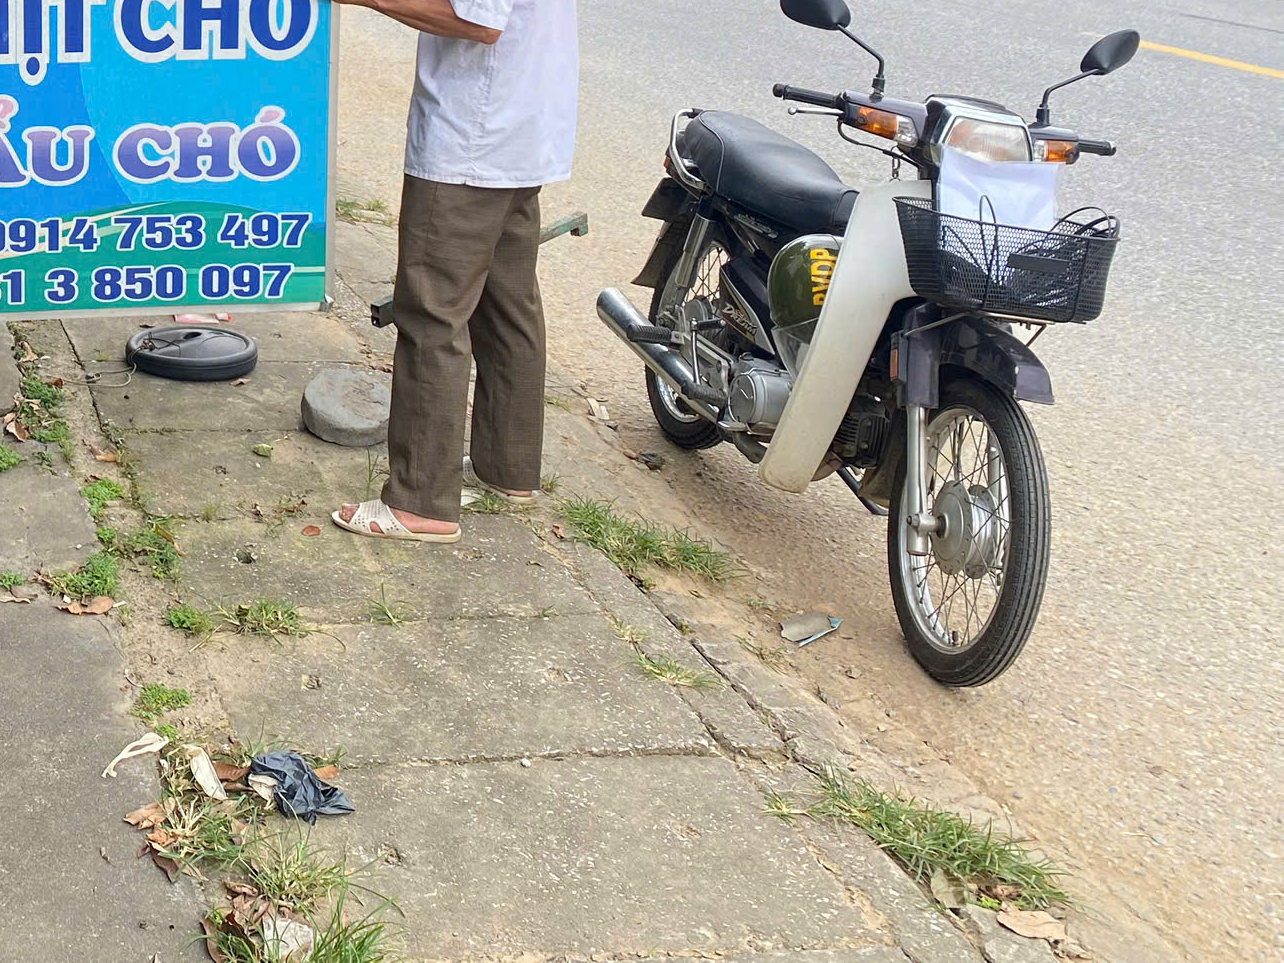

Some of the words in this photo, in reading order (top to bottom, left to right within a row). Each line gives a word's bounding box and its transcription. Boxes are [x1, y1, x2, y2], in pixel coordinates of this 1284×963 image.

[113, 105, 300, 183] CHÓ
[114, 213, 206, 252] 753
[220, 212, 312, 249] 497
[44, 268, 78, 304] 3
[91, 265, 186, 304] 850
[200, 263, 294, 300] 097
